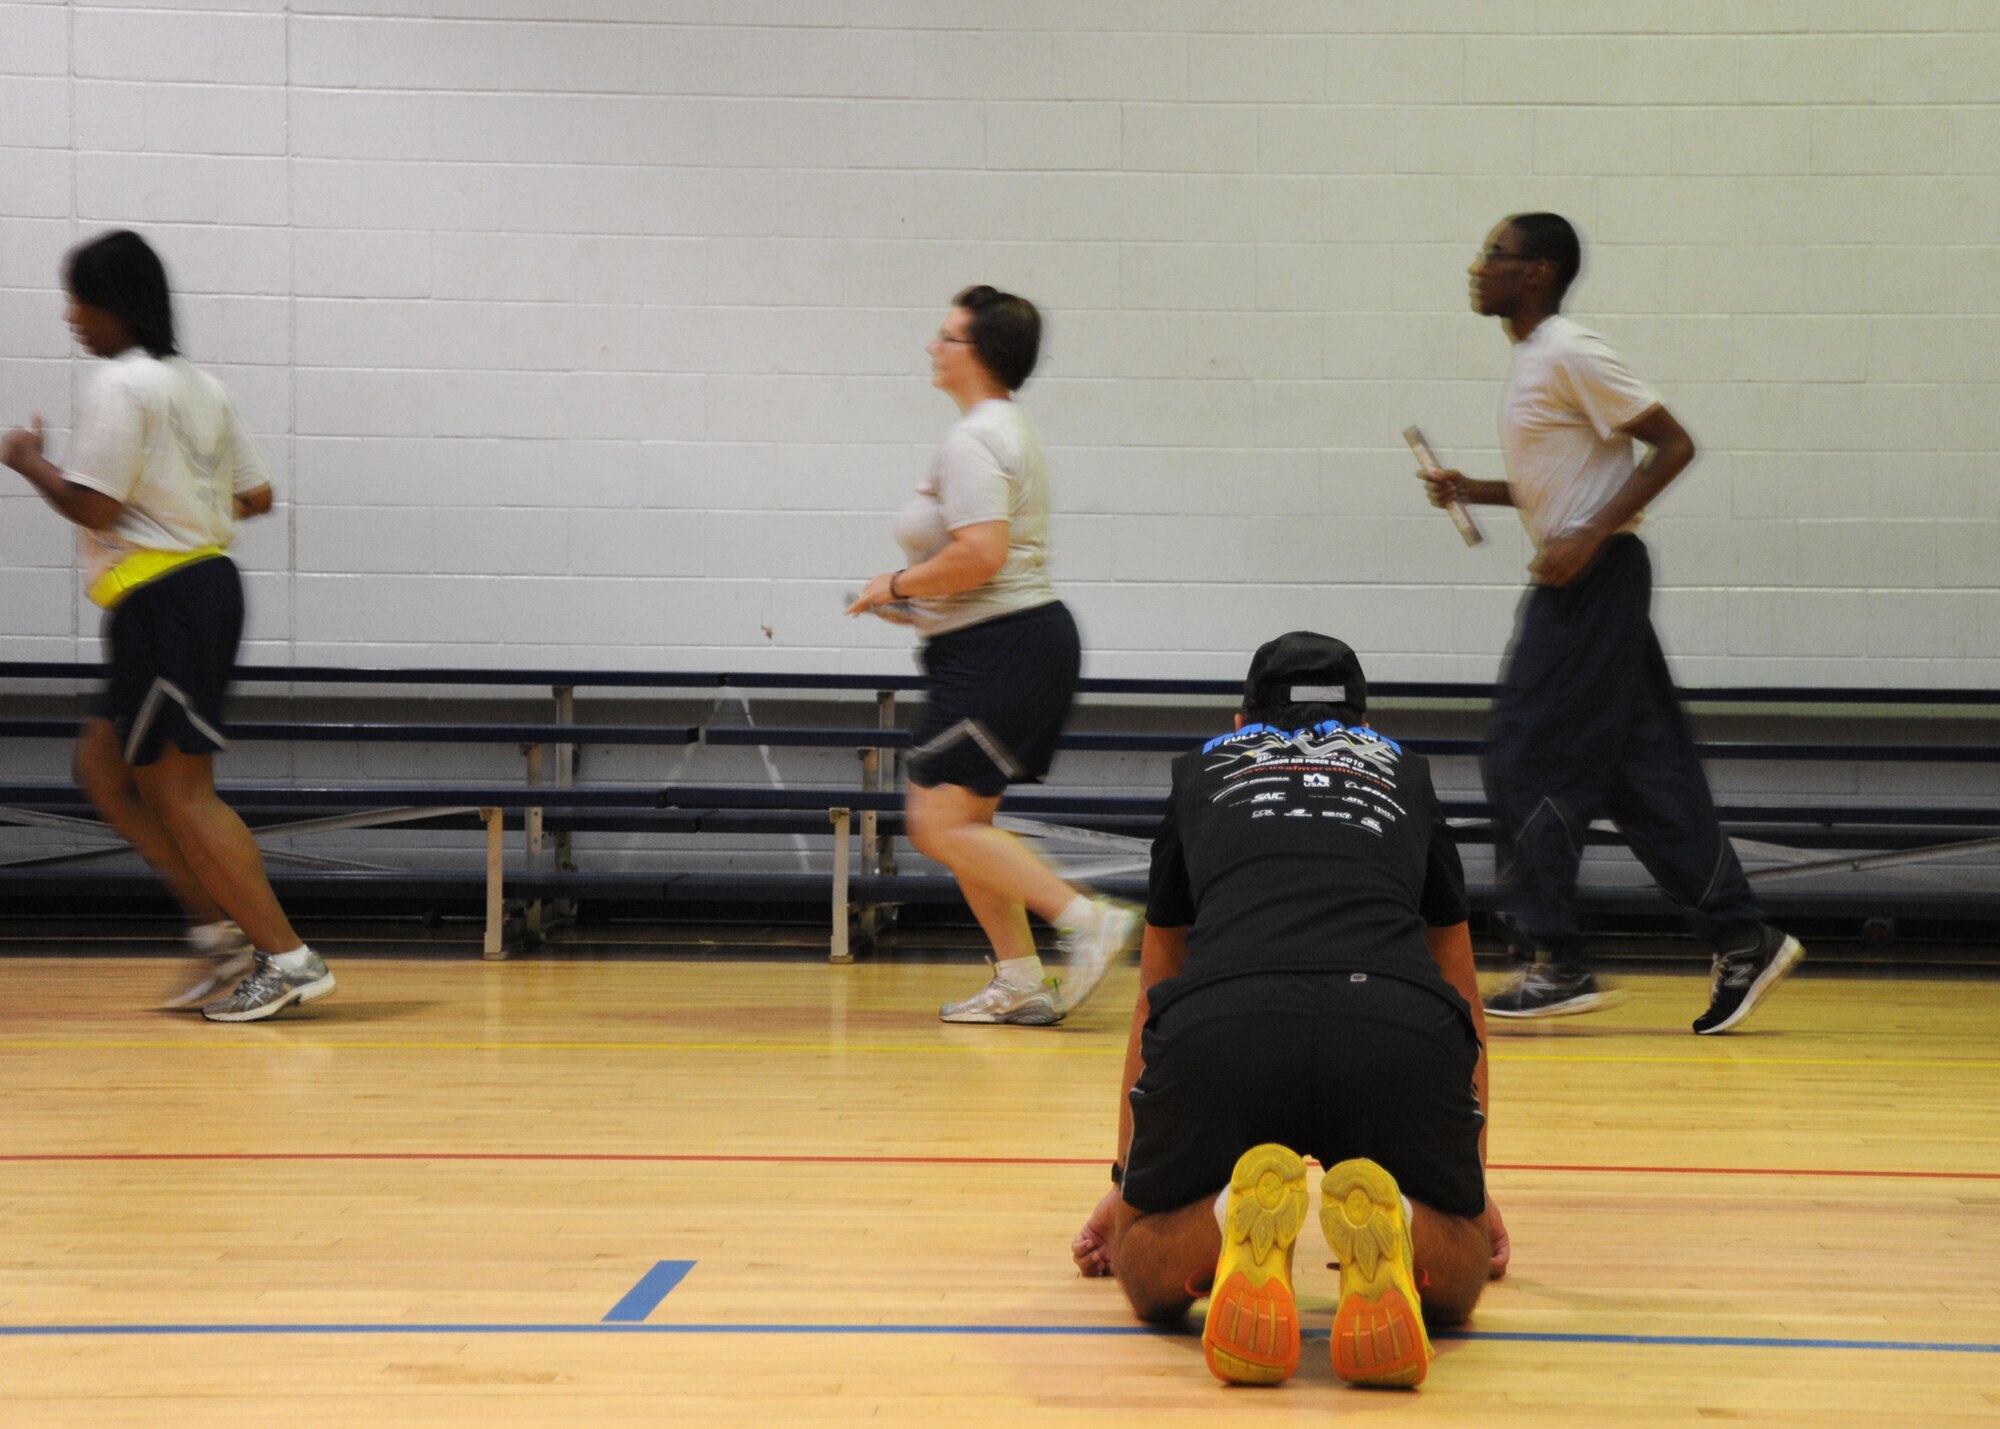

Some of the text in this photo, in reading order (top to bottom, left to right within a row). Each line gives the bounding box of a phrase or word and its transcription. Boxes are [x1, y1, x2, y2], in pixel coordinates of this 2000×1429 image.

[1340, 756, 1364, 768] 2010
[1254, 792, 1287, 801] SAIC
[1361, 786, 1407, 816] BOEING
